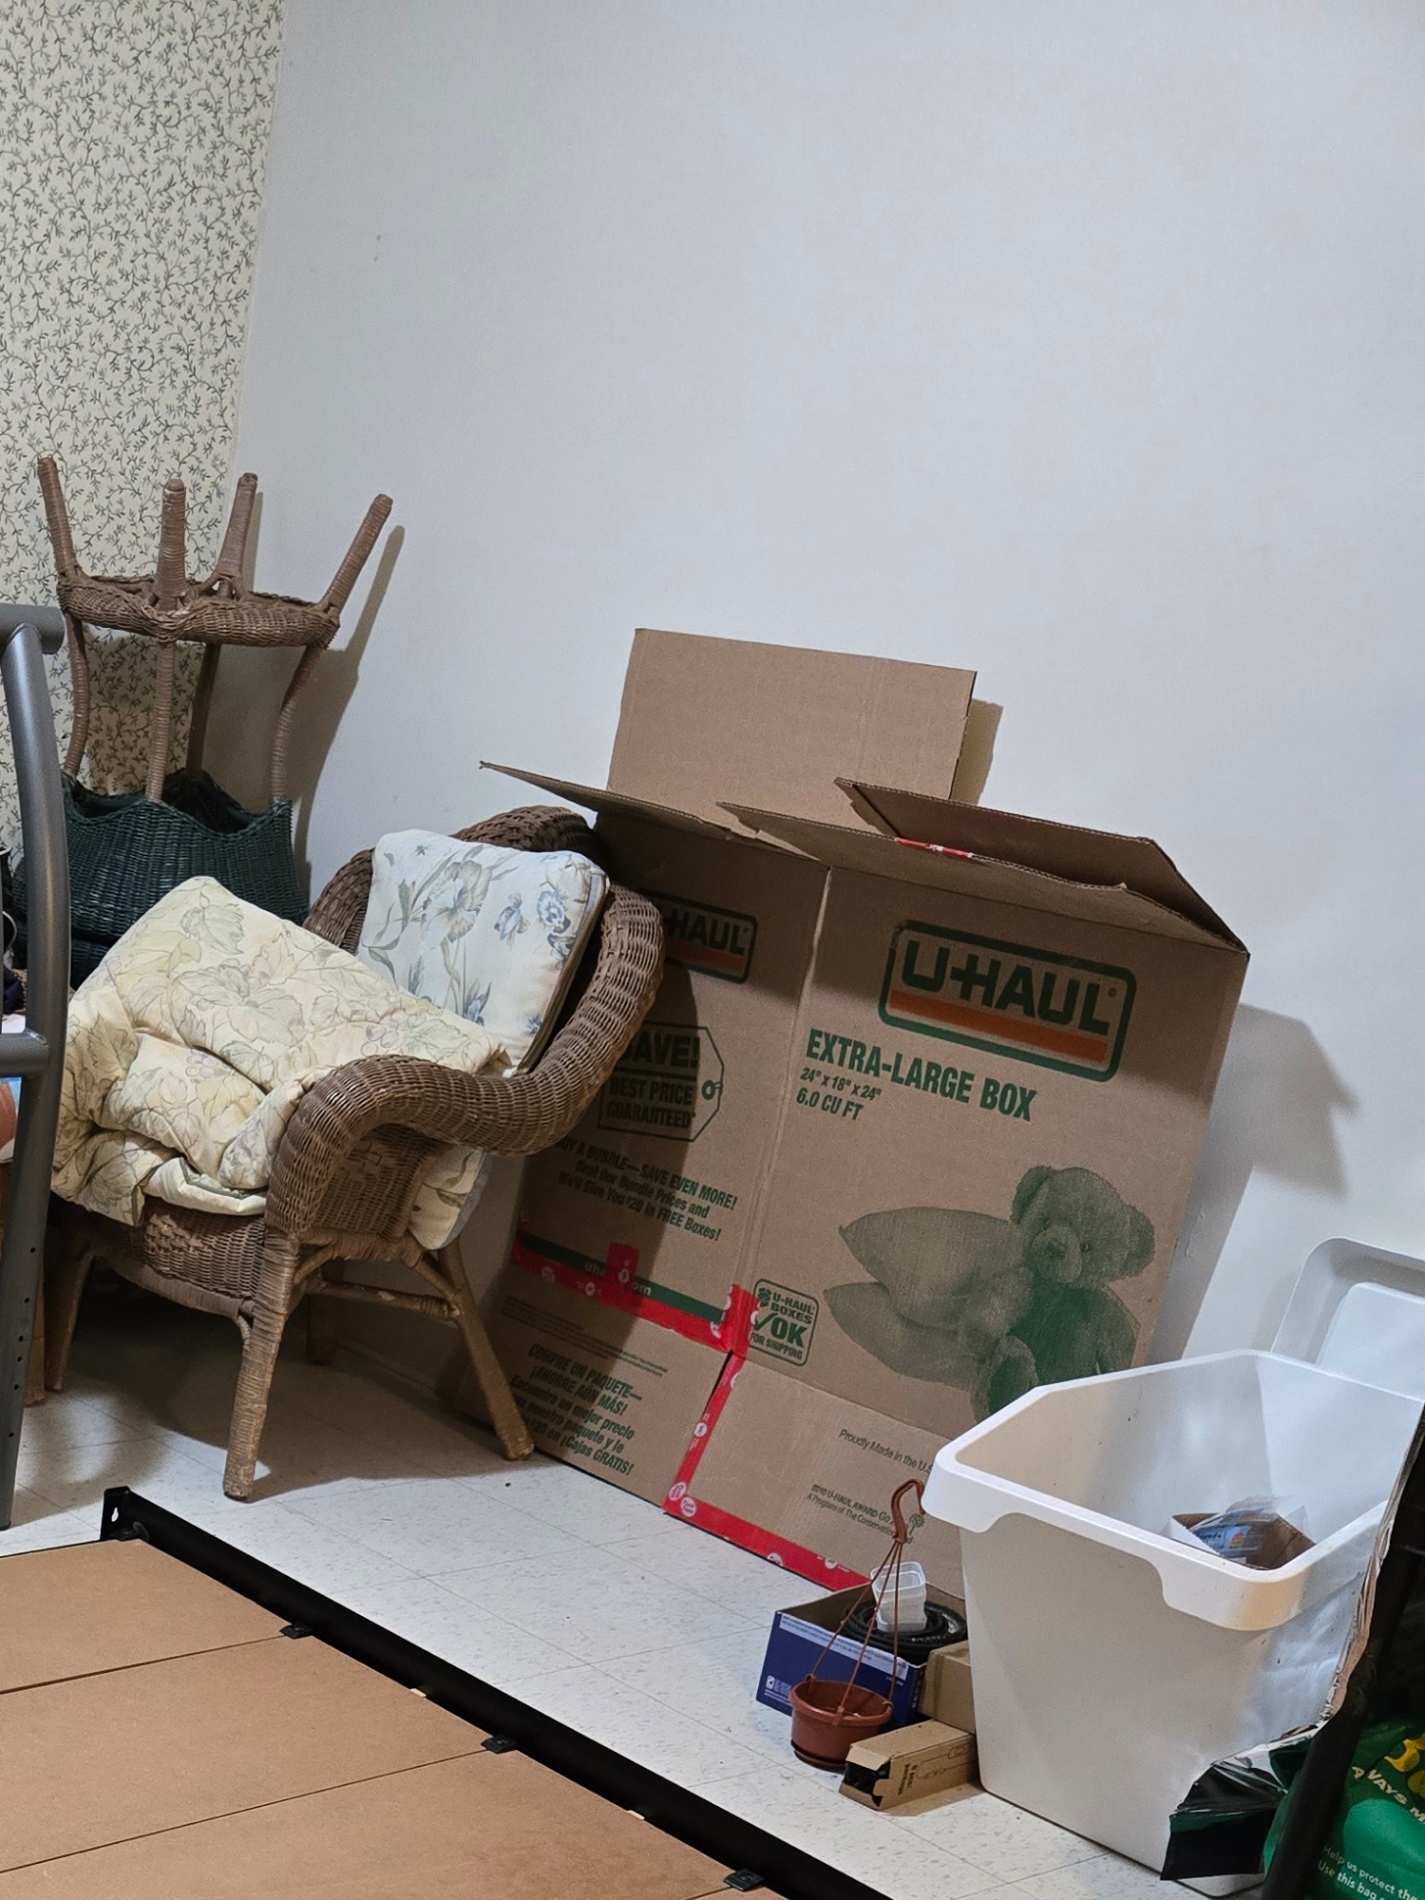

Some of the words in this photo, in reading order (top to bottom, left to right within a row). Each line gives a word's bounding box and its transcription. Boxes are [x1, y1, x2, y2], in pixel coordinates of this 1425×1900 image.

[658, 906, 745, 956] -HAUL
[902, 939, 1111, 1036] U-HAUL
[622, 1030, 700, 1069] AVE!
[609, 1076, 647, 1099] BEST
[650, 1081, 693, 1106] PRICE
[800, 1068, 822, 1083] 24"
[831, 1075, 852, 1092] 18"
[861, 1084, 882, 1101] 24"
[806, 1029, 975, 1104] EXTRA-LARGE
[979, 1078, 1038, 1121] BOX
[606, 1101, 692, 1129] GUARANTEED
[797, 1087, 820, 1108] 6.0
[821, 1095, 841, 1115] CU
[842, 1100, 864, 1121] FT
[583, 1180, 605, 1198] Give
[607, 1187, 625, 1205] You
[644, 1201, 655, 1216] in
[656, 1207, 684, 1228] FREE
[684, 1218, 722, 1242] Boxes!
[599, 1168, 618, 1185] Our
[618, 1175, 655, 1198] Bundle
[655, 1188, 687, 1212] Prices
[688, 1202, 711, 1219] and
[669, 1175, 700, 1196] EVEN
[699, 1185, 738, 1211] MORE!
[584, 1261, 652, 1297] uhaom
[770, 1302, 813, 1325] BOXES
[772, 1292, 814, 1316] U-HAUL
[750, 1331, 765, 1346] FOR
[765, 1338, 803, 1361] SHIPPING
[770, 1317, 807, 1348] OK
[528, 1343, 570, 1371] COMPRE
[570, 1361, 588, 1379] UN
[558, 1398, 572, 1412] un
[572, 1402, 603, 1425] mejor
[601, 1418, 635, 1441] precio
[598, 1395, 629, 1416] MÁS!
[526, 1402, 564, 1426] nuestro
[562, 1419, 605, 1446] paquete
[604, 1436, 613, 1450] y
[611, 1439, 625, 1454] le
[547, 1428, 561, 1442] en
[593, 1449, 635, 1476] GRATIS!
[838, 1428, 871, 1450] Proudly
[870, 1441, 894, 1460] Made
[894, 1450, 903, 1463] in
[902, 1453, 917, 1468] the
[917, 1459, 934, 1475] U.S
[811, 1494, 838, 1513] Program
[845, 1507, 858, 1521] The
[857, 1514, 896, 1540] Conservatio
[878, 1510, 892, 1523] Go
[1318, 1860, 1335, 1877] Use
[1337, 1872, 1356, 1888] this
[1323, 1844, 1345, 1865] Help
[1346, 1861, 1358, 1872] us
[1359, 1869, 1395, 1894] protect
